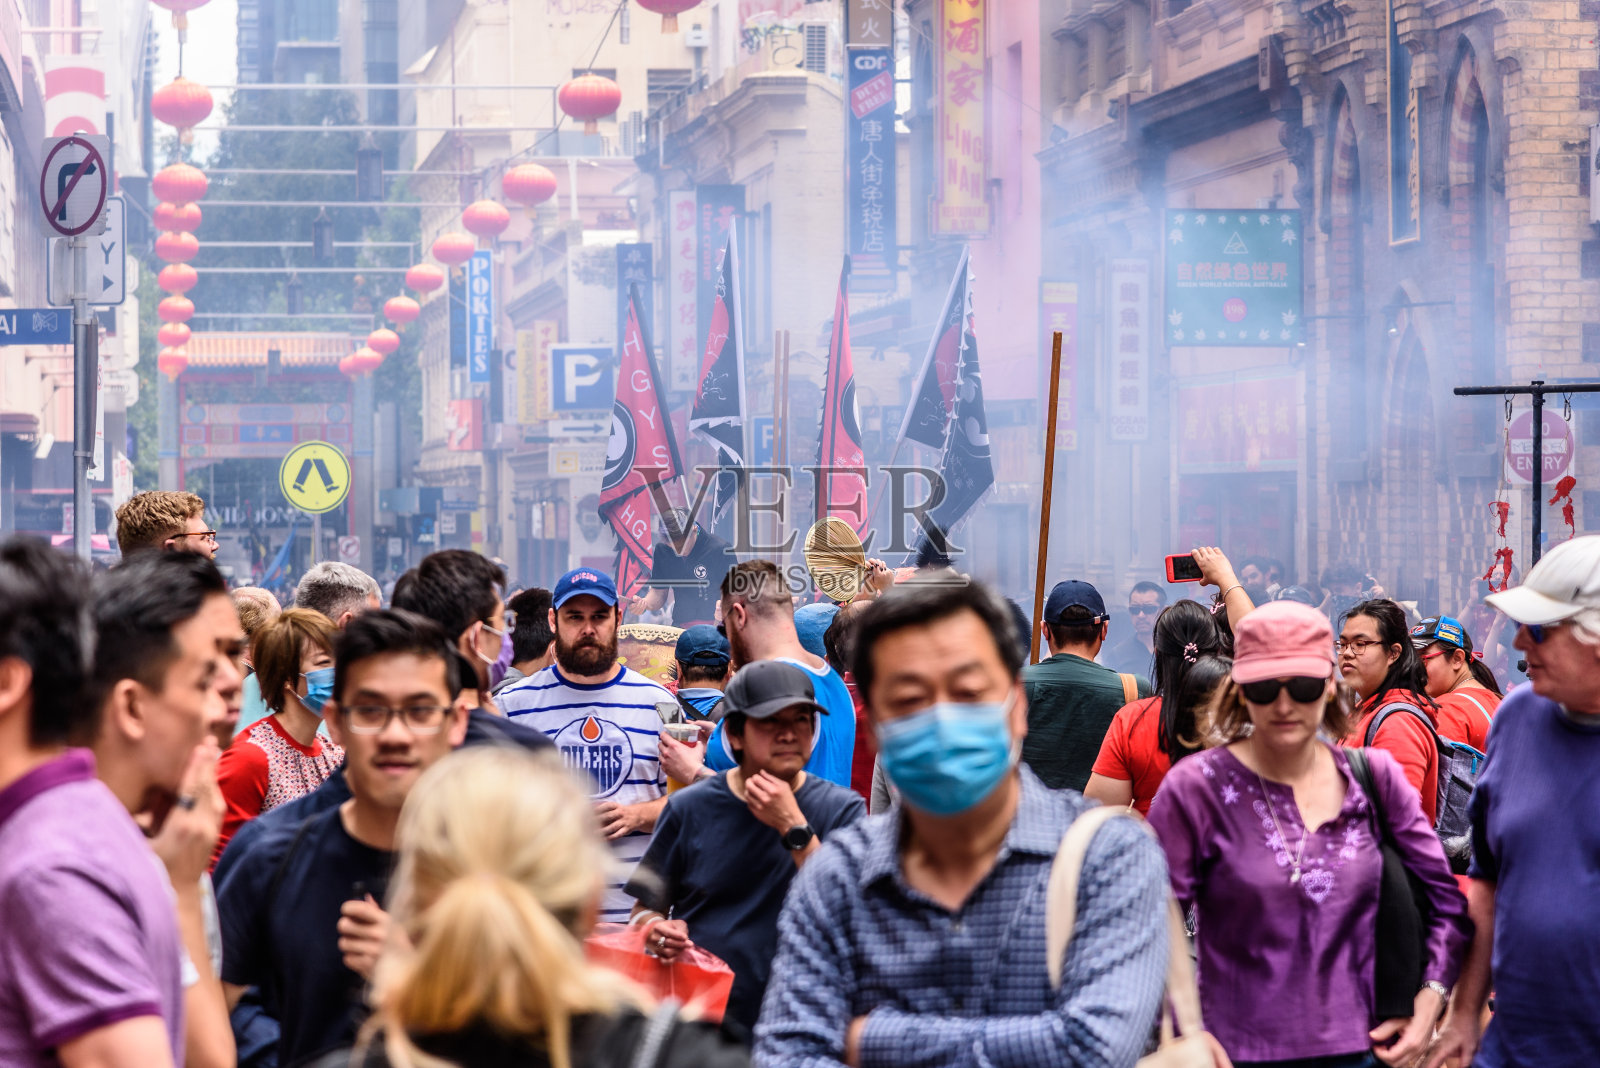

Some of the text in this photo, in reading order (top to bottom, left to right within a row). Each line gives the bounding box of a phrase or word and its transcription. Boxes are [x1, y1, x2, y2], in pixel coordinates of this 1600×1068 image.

[946, 0, 982, 107] 酒家
[855, 76, 887, 100] DUTY
[858, 90, 889, 114] FREE
[946, 114, 982, 164] LING
[947, 158, 981, 200] NAN
[472, 256, 490, 373] POKIES
[564, 354, 602, 403] P
[1111, 416, 1147, 425] OCEAN
[1116, 425, 1145, 435] GOLD
[1529, 422, 1551, 437] O
[1516, 456, 1563, 471] ENRY
[561, 744, 623, 769] OILERS
